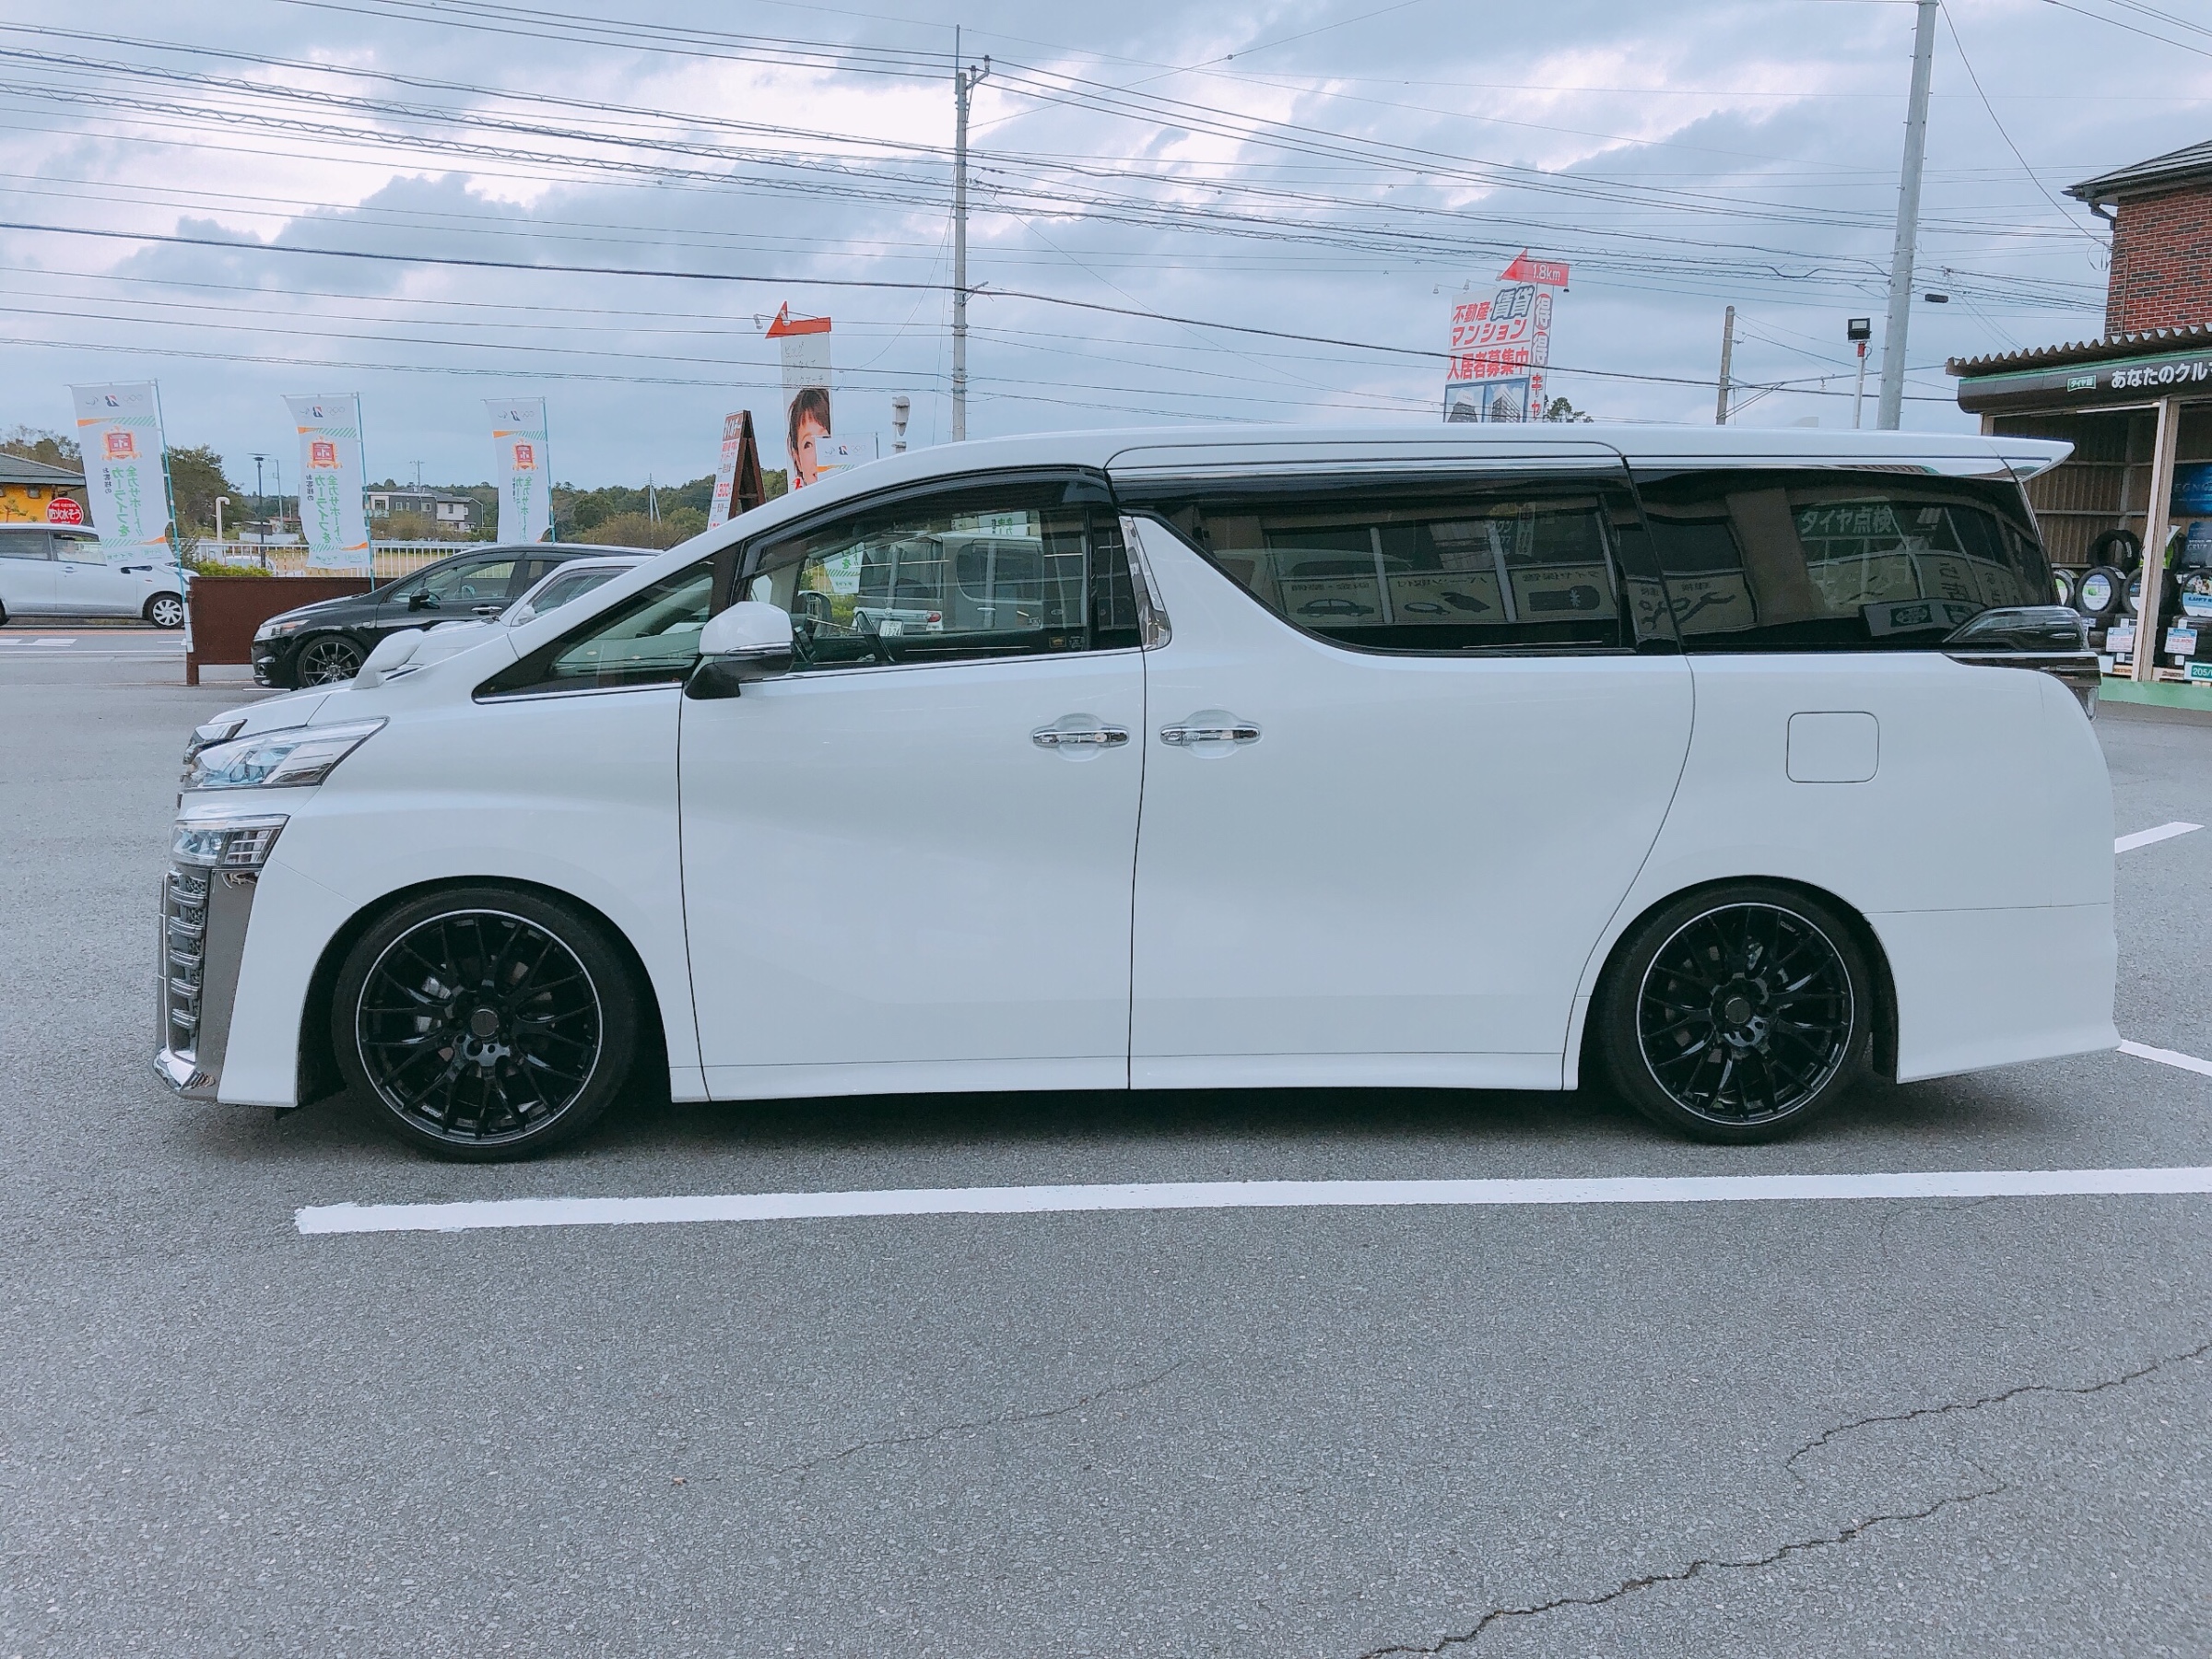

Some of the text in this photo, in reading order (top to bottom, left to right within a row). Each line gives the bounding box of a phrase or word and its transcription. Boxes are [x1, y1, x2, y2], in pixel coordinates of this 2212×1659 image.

[1532, 263, 1561, 282] 1.8km
[1451, 319, 1528, 347] マンション
[1446, 347, 1530, 381] 入居者募集中
[2111, 361, 2212, 389] あなたのクル
[48, 508, 81, 521] 防火水そう
[1800, 505, 1894, 534] タイヤ点検
